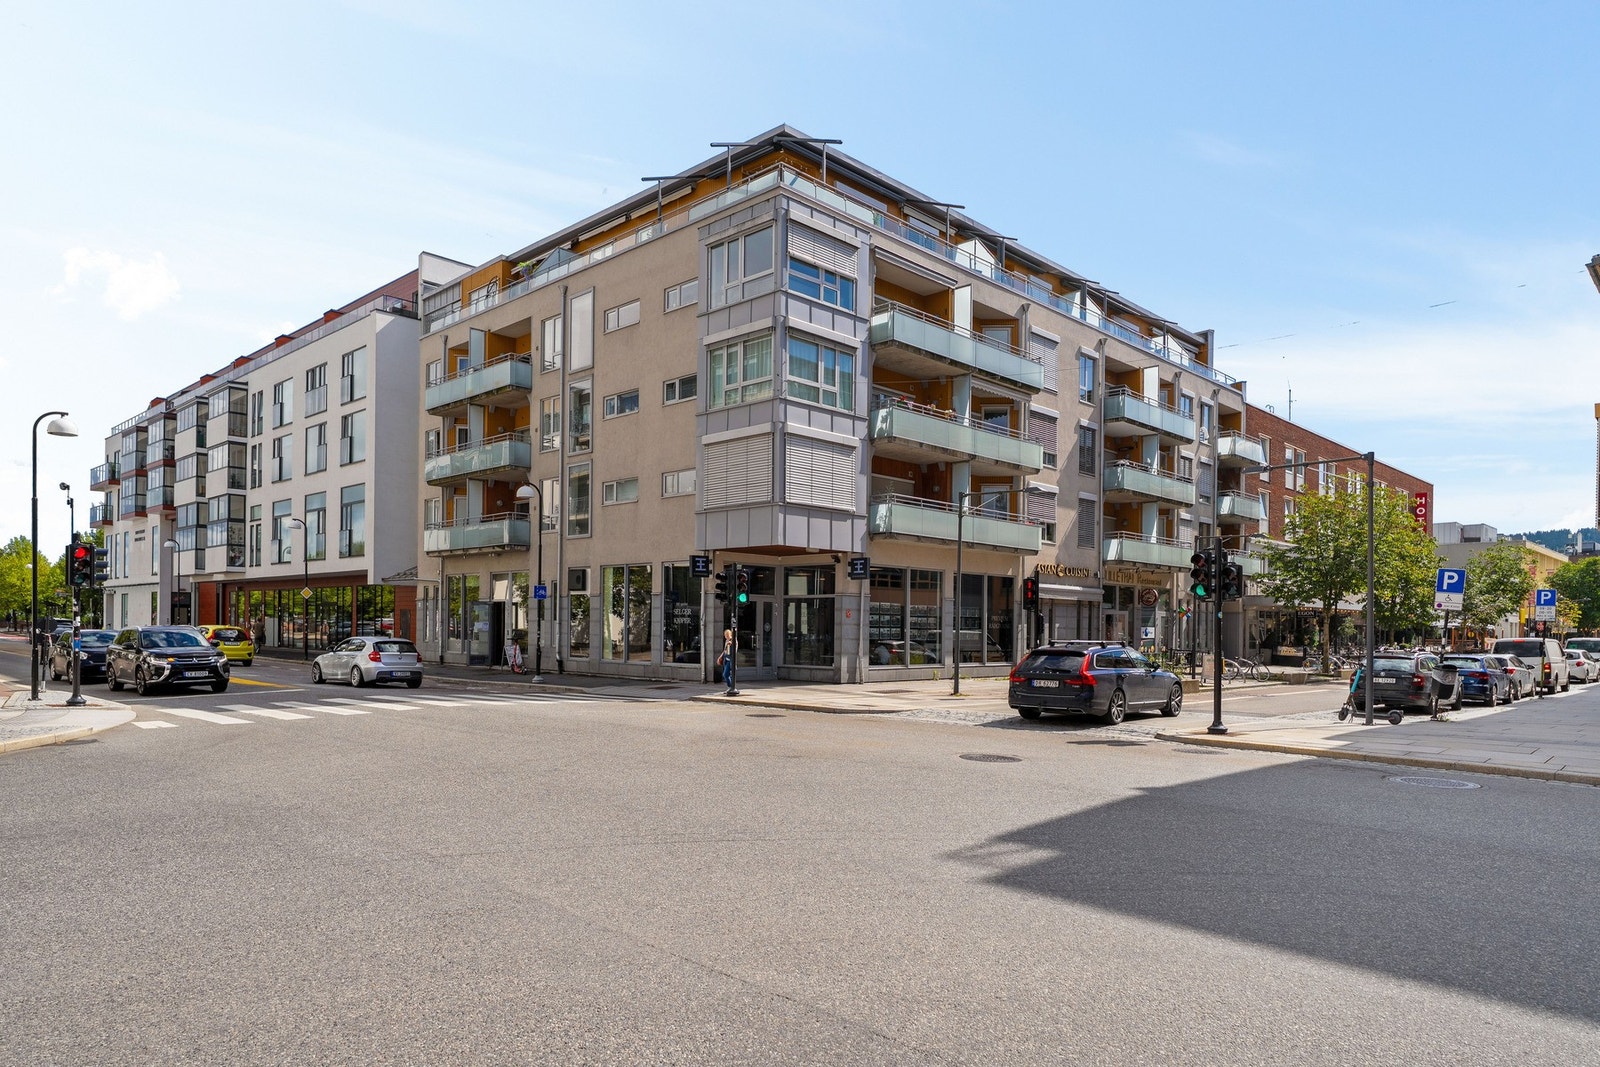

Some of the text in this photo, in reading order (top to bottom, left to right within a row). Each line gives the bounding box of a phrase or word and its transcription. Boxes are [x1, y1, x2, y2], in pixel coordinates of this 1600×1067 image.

[1035, 563, 1057, 575] ASIAN
[1442, 571, 1459, 590] P
[1540, 591, 1552, 604] P
